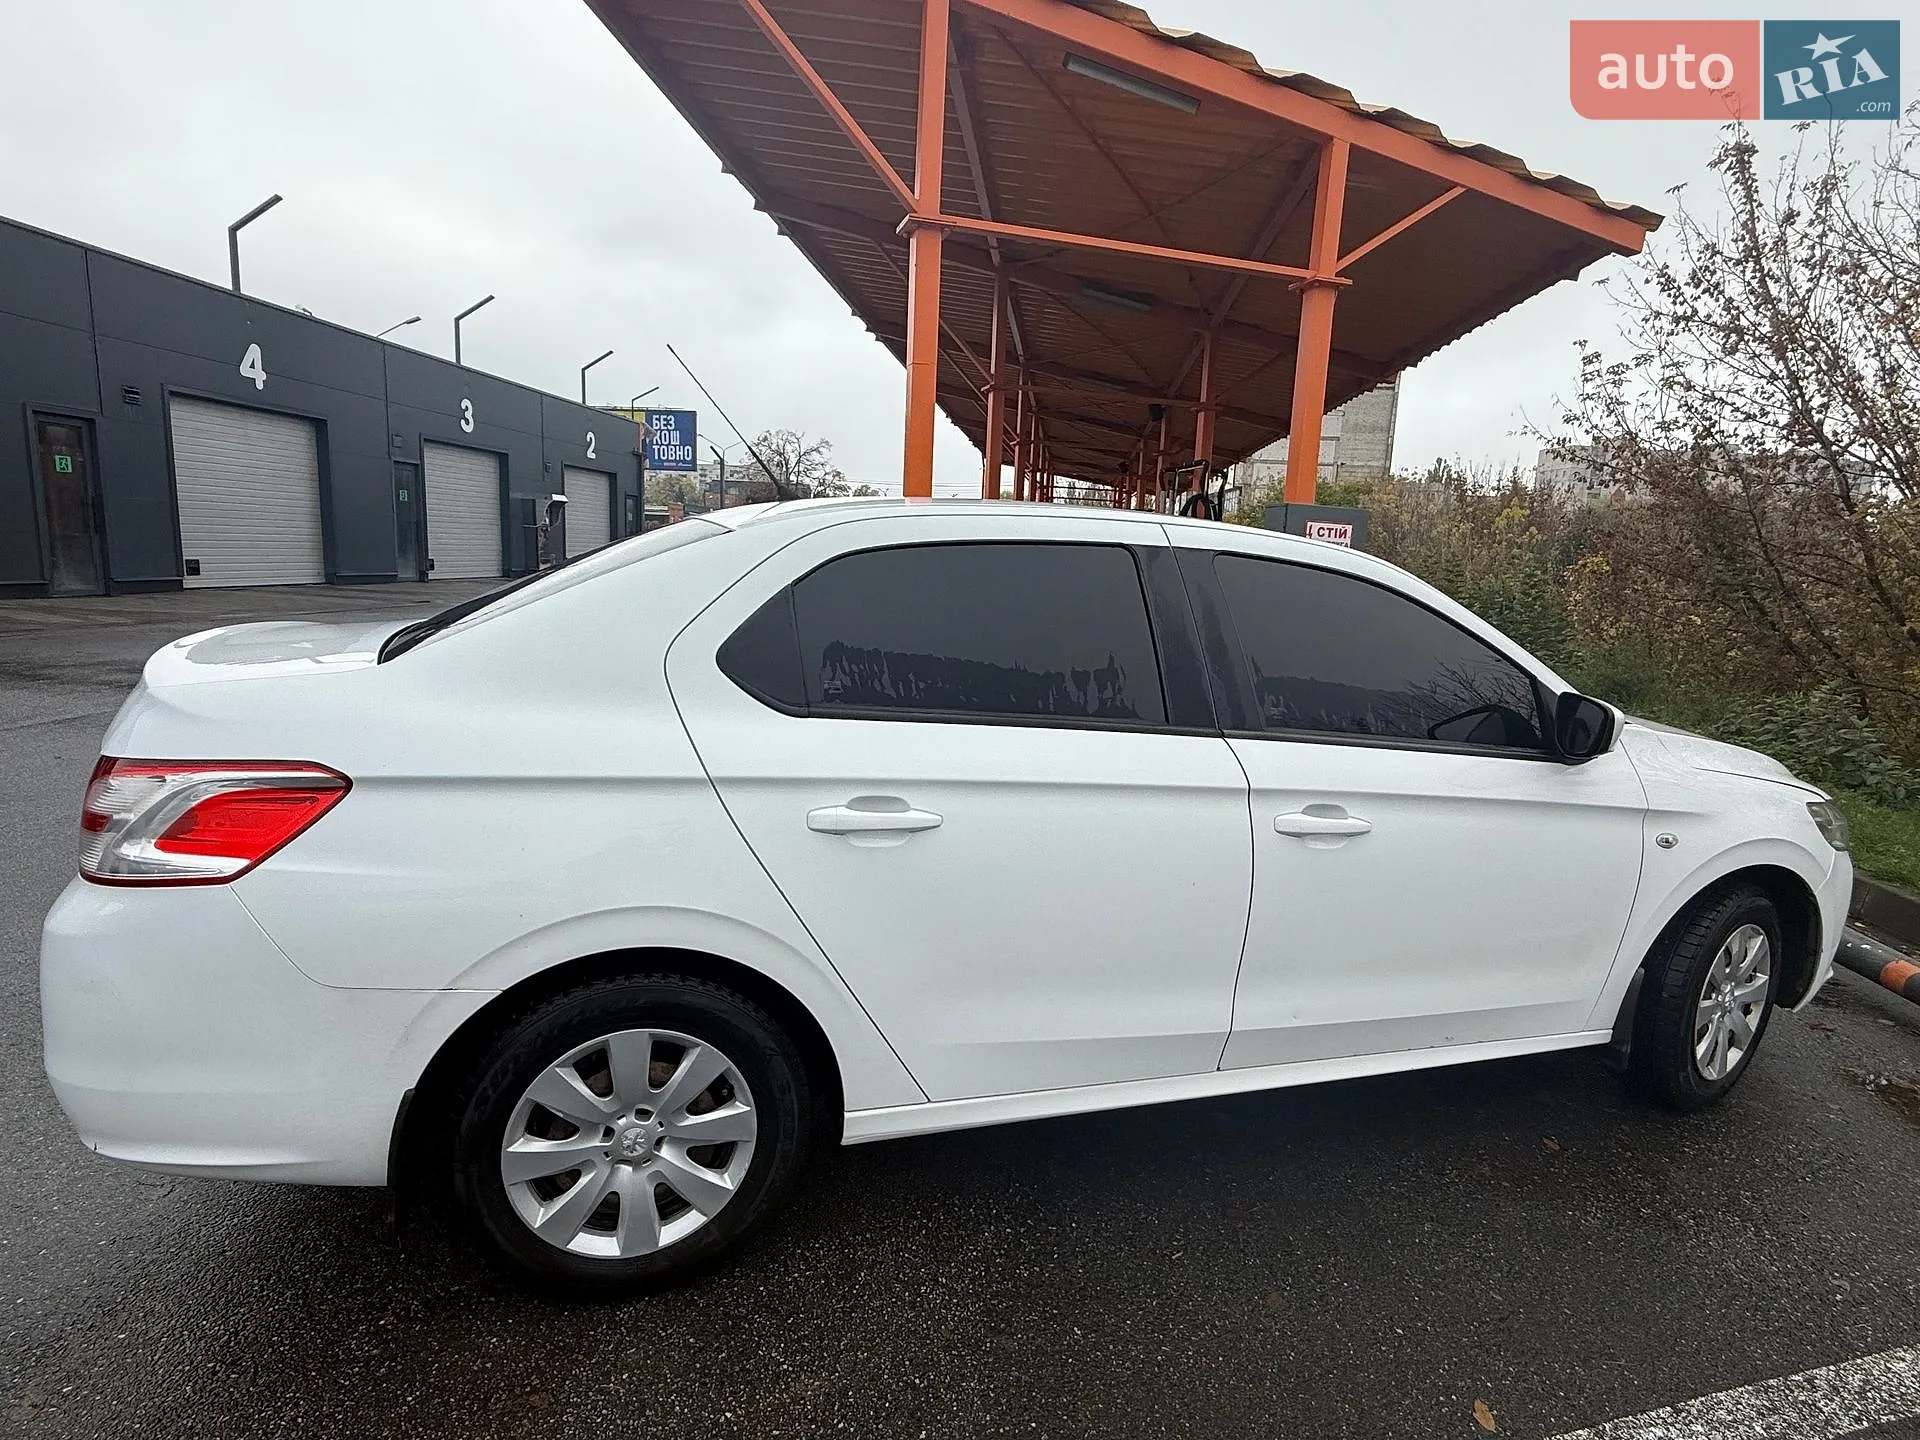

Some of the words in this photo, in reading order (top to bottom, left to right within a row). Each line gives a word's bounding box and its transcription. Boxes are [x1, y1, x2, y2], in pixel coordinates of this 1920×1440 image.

[239, 343, 267, 390] 4
[460, 398, 474, 434] 3
[652, 414, 675, 430] БЕЗ
[585, 431, 597, 460] 2
[652, 445, 692, 461] ТОВНО
[1317, 526, 1348, 539] СТІЙ
